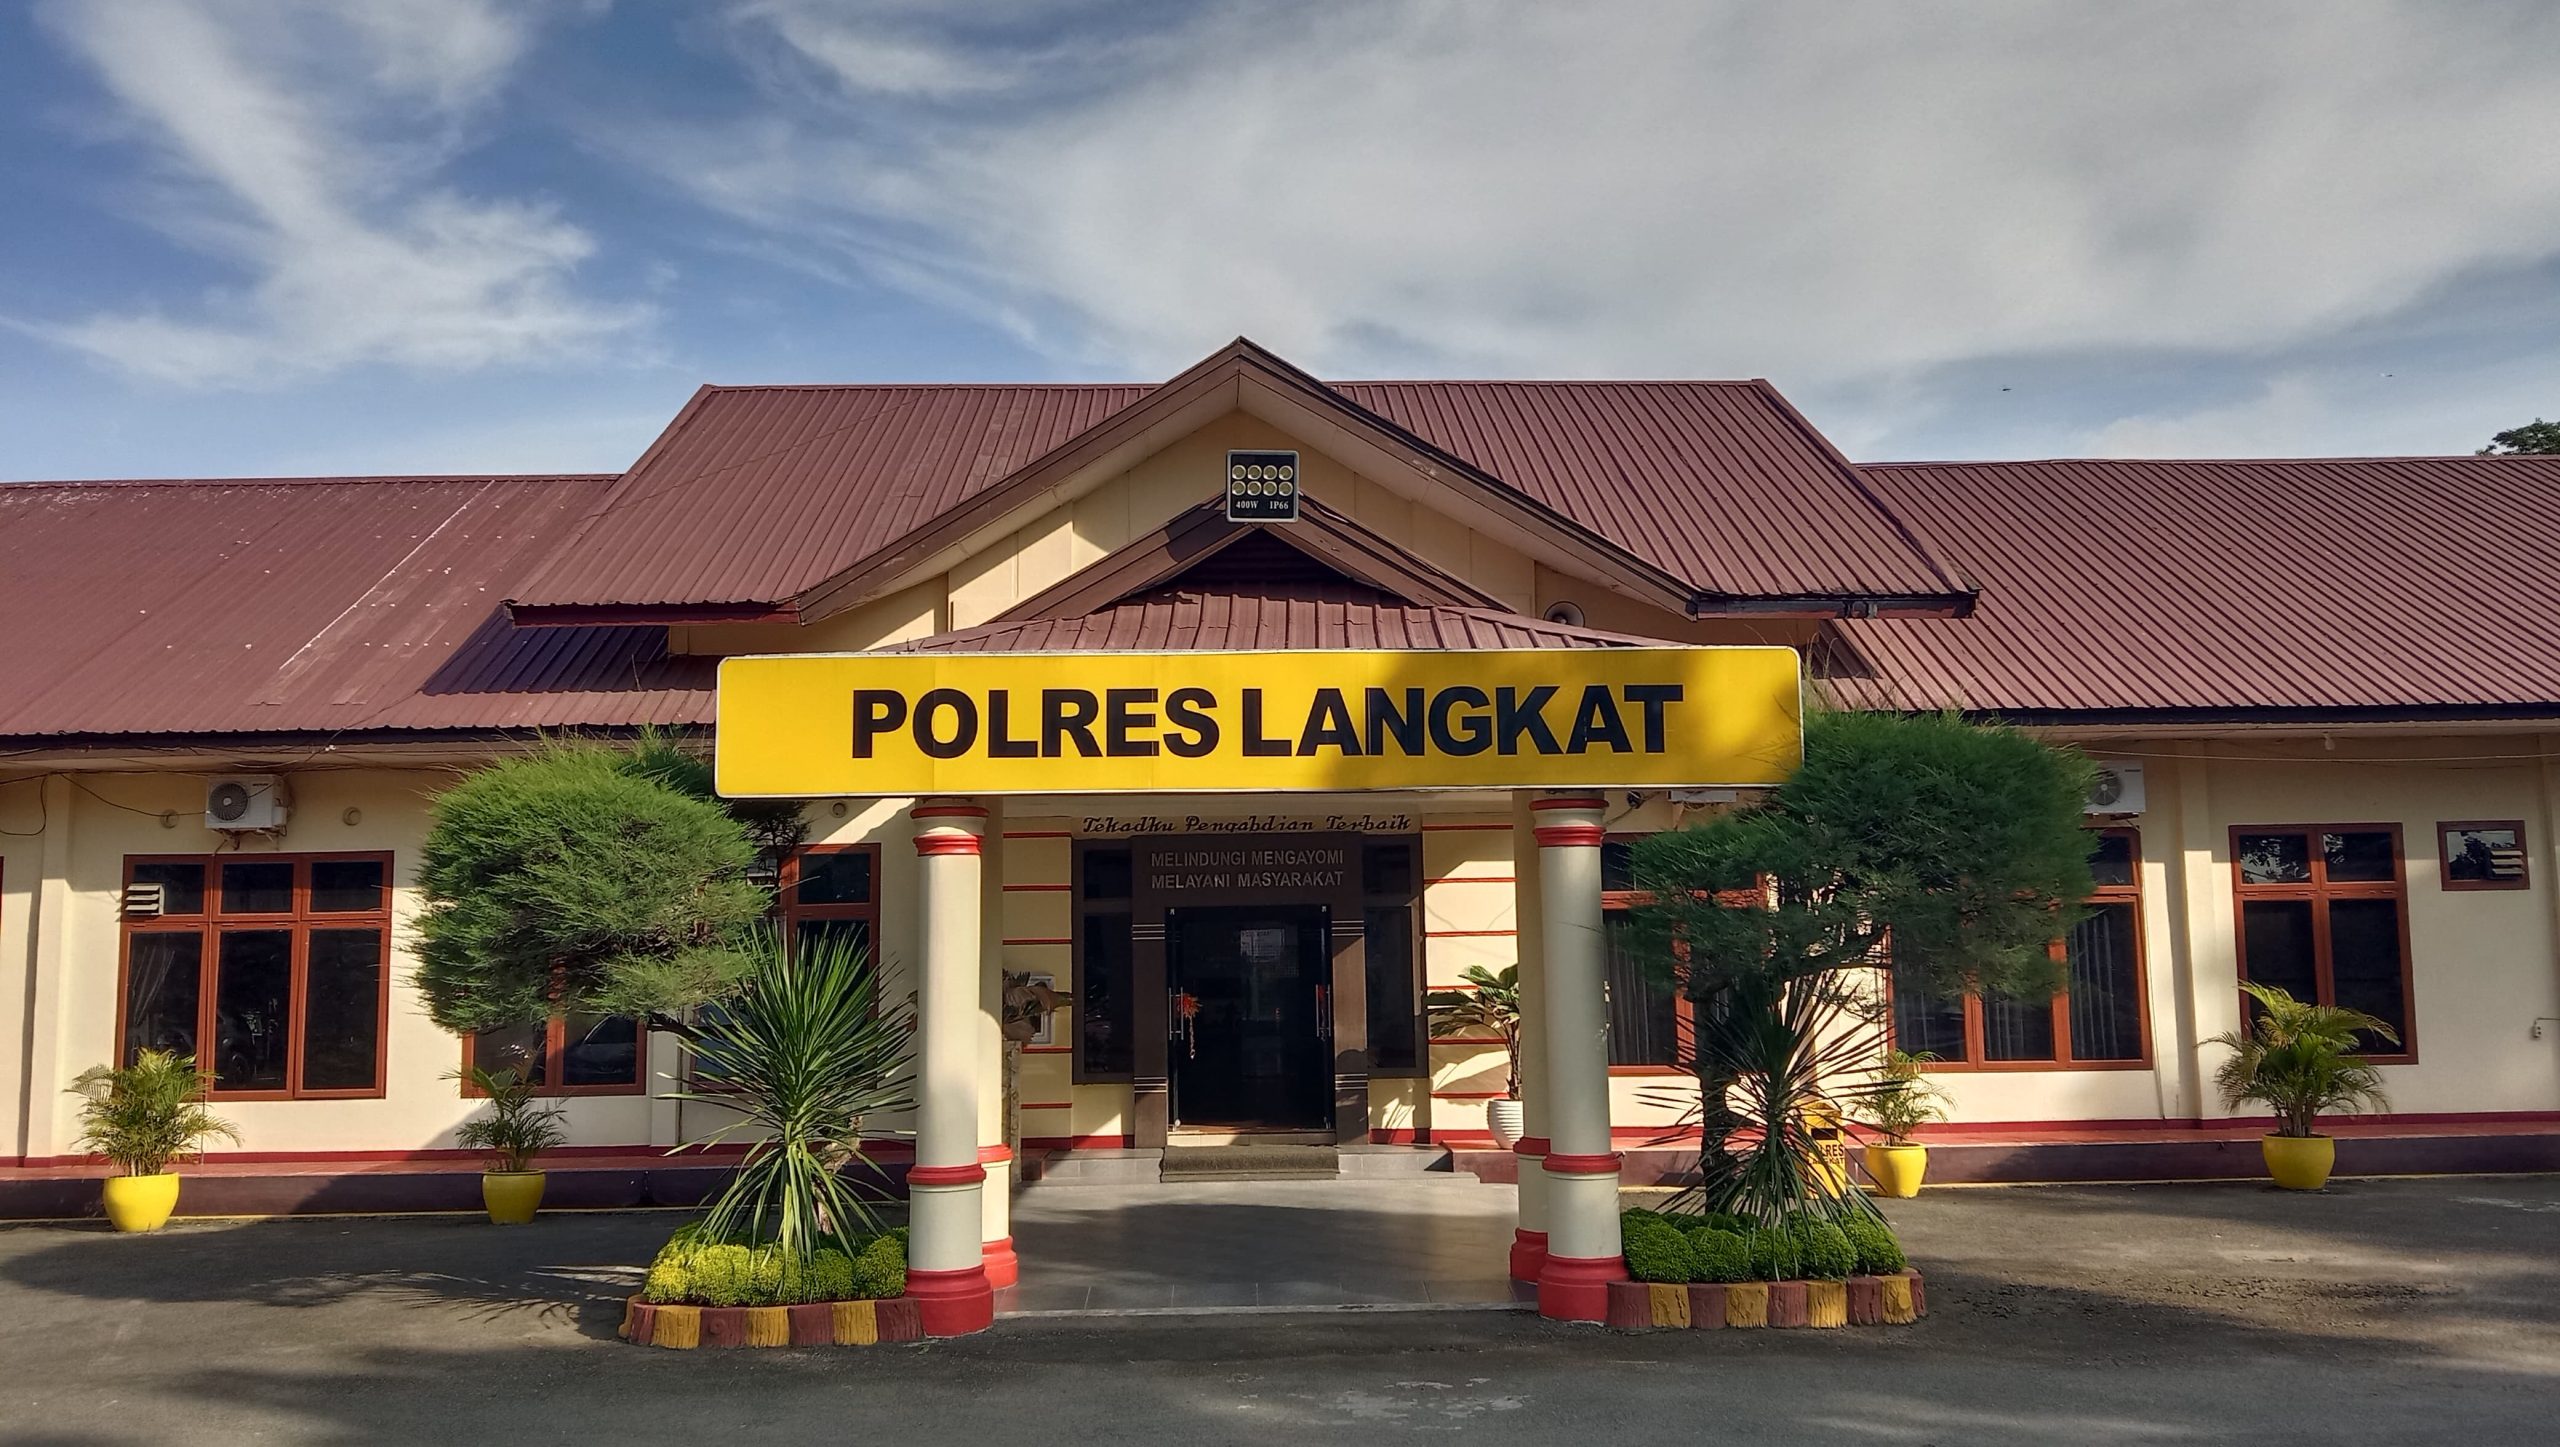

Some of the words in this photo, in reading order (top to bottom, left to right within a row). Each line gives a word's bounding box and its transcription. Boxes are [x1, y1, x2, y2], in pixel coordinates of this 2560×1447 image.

[1236, 500, 1259, 509] 400W
[1269, 500, 1289, 509] IP66
[853, 687, 1220, 758] POLRES
[1243, 685, 1683, 757] LANGKAT
[1083, 816, 1176, 832] Tekadku
[1185, 815, 1314, 833] Pengabdian
[1326, 814, 1411, 831] Terbaik
[1151, 851, 1246, 867] MELINDUNGI
[1251, 850, 1343, 865] MENGAYOMI
[1151, 874, 1230, 889] MELAYANI
[1238, 871, 1344, 887] MASYARAKAT
